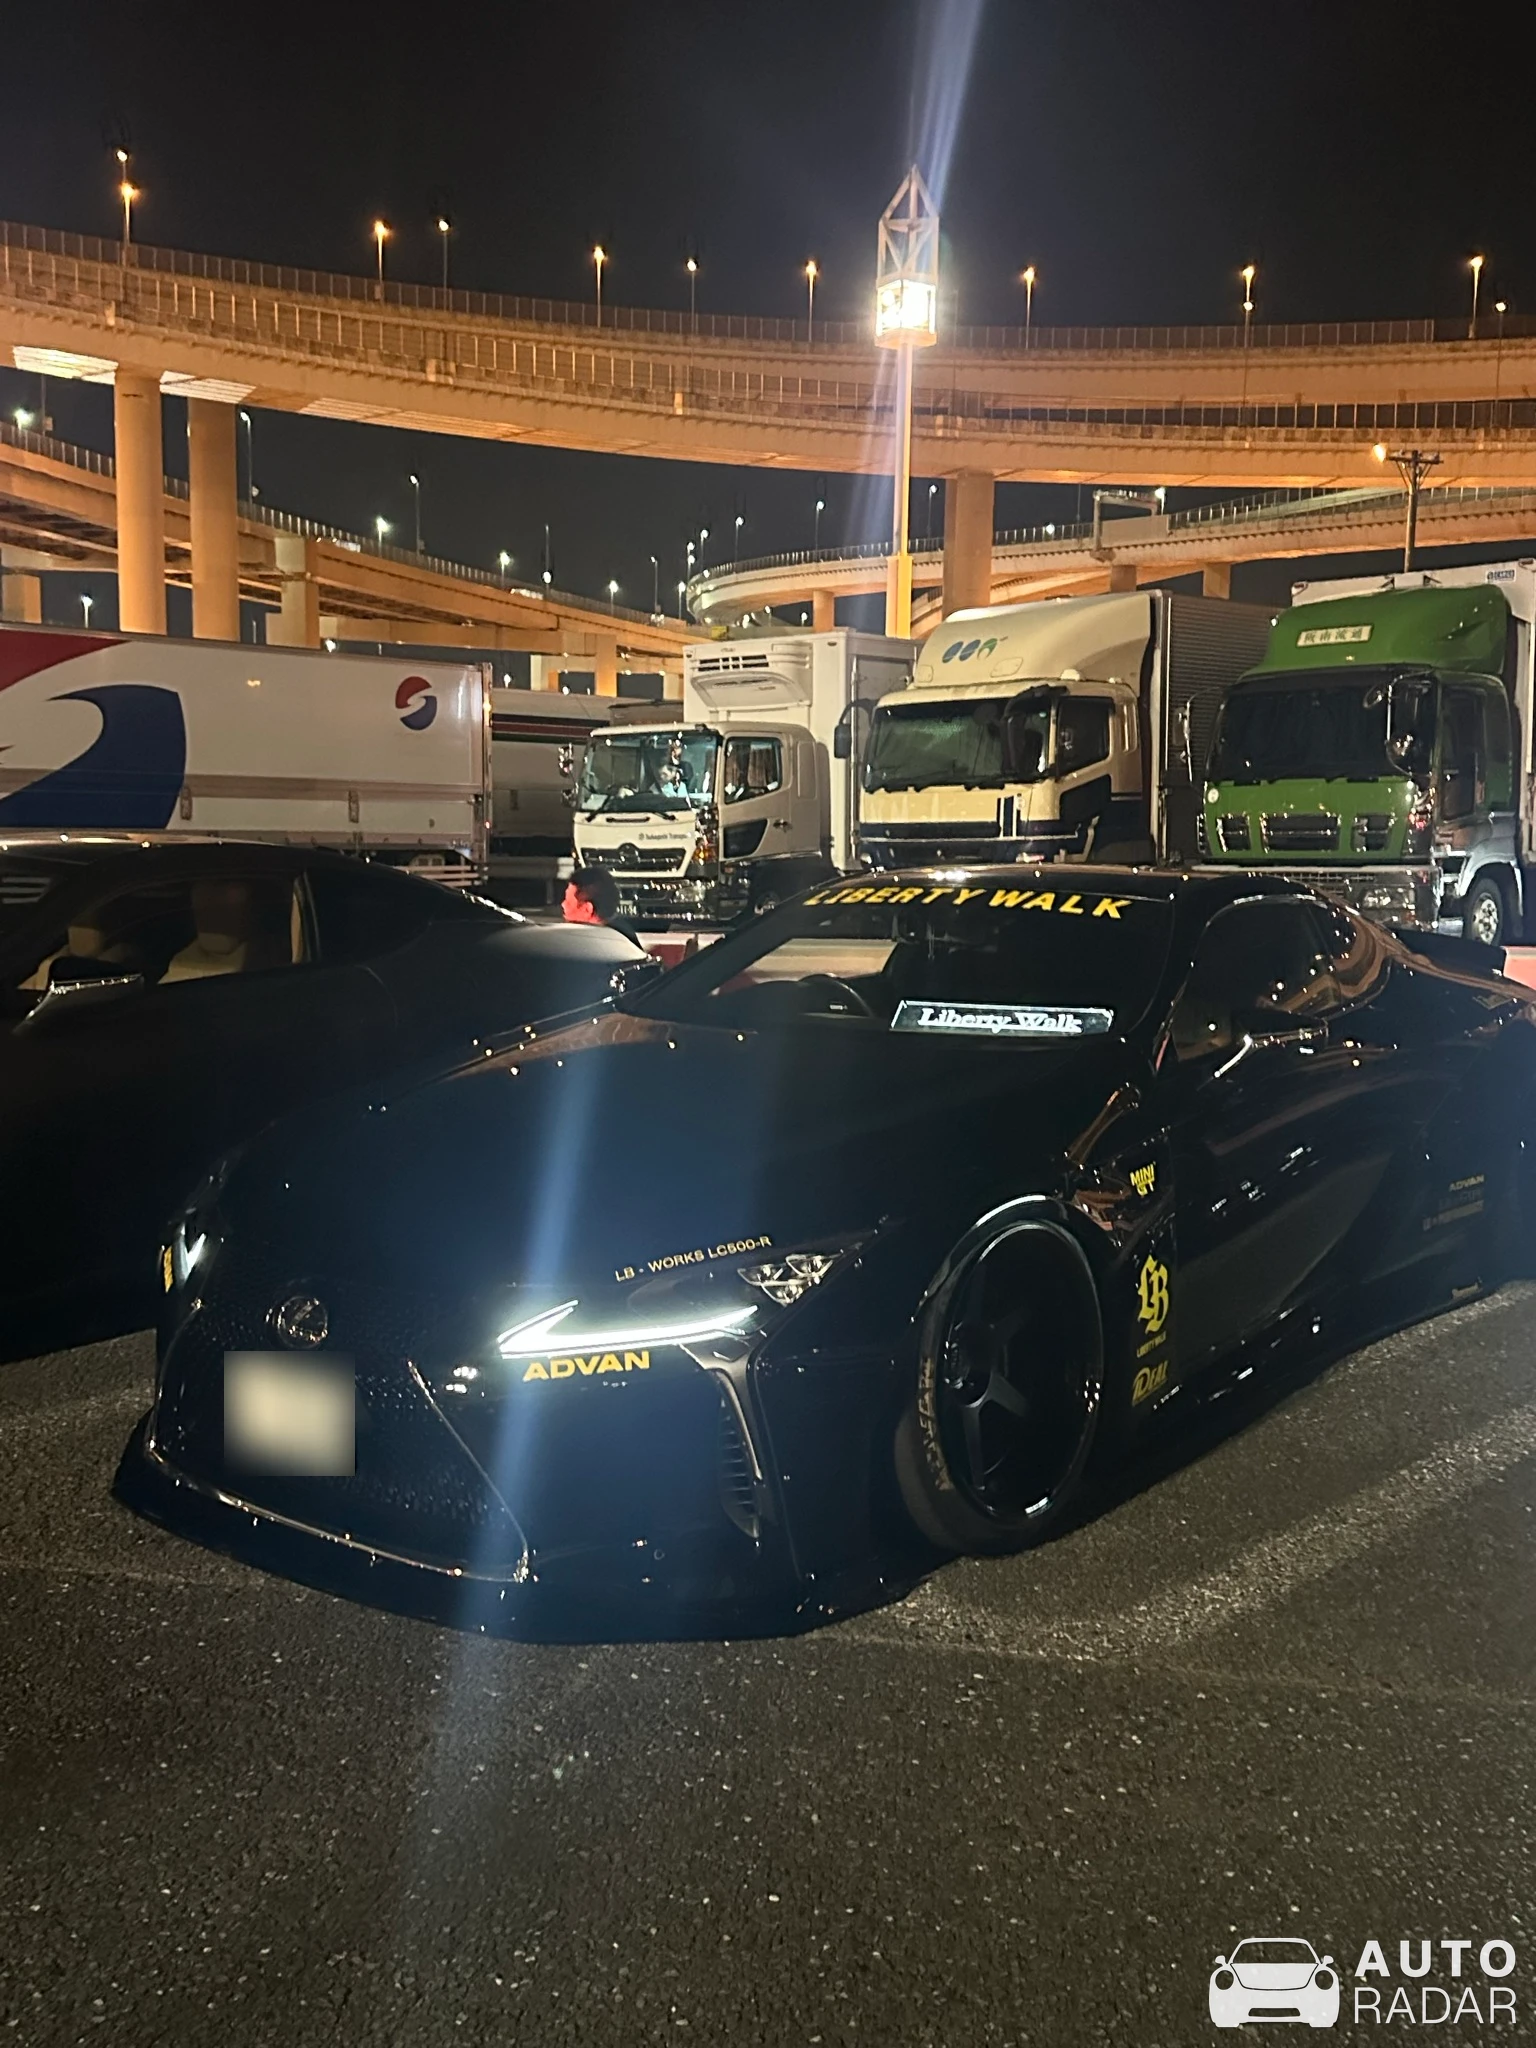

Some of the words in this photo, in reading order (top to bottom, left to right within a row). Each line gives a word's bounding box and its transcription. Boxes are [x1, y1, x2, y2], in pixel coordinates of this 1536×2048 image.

[803, 887, 987, 906] LIBERTY
[988, 889, 1132, 919] WALK
[917, 1007, 1012, 1034] Liberty
[1012, 1012, 1083, 1034] Walk
[1130, 1163, 1155, 1186] MINI
[1449, 1174, 1485, 1192] ADVAN
[615, 1266, 635, 1282] LB
[647, 1249, 704, 1273] WORKS
[707, 1235, 772, 1259] LC500-R
[522, 1350, 650, 1383] ADVAN
